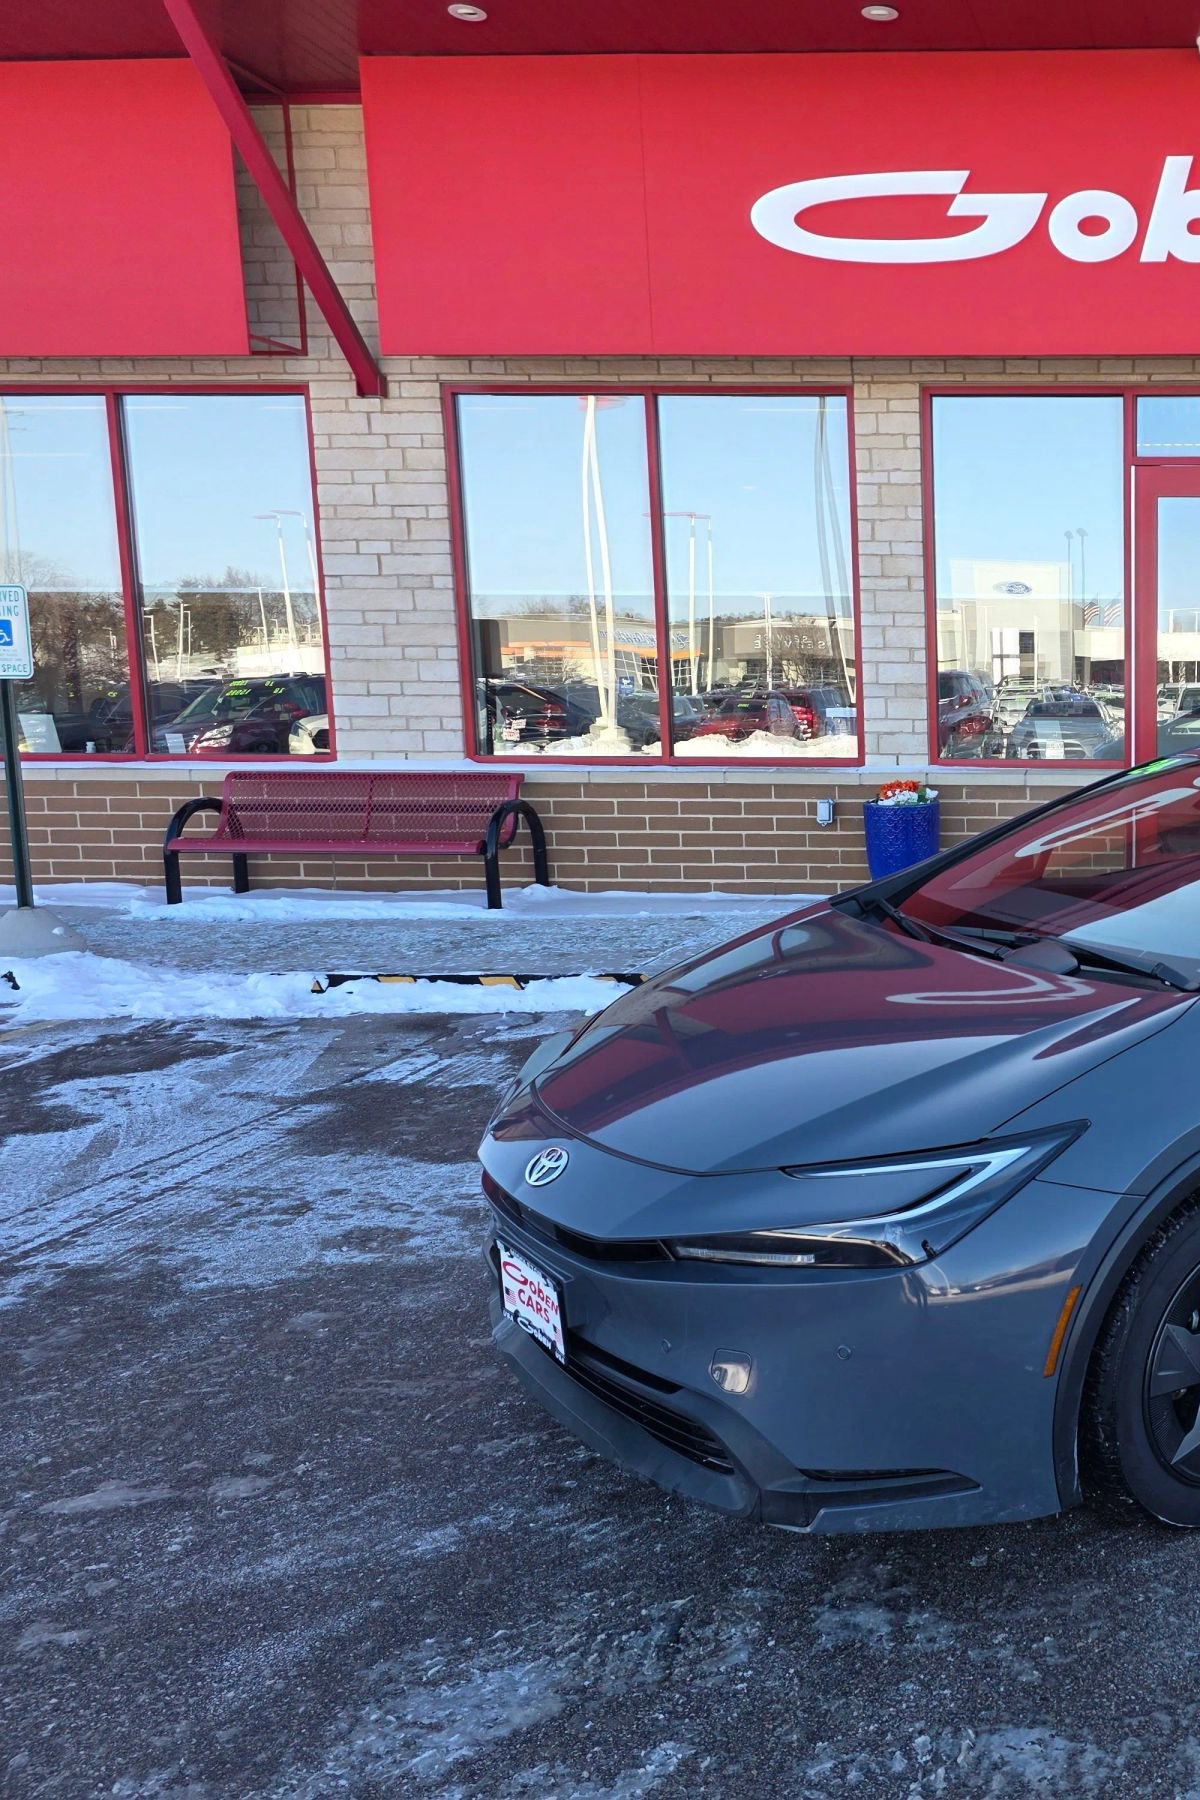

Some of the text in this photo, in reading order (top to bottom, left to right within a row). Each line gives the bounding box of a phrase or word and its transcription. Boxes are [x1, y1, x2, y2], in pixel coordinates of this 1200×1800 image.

[0, 590, 19, 602] VED
[1, 663, 28, 673] SPACE
[517, 1288, 551, 1325] CARS
